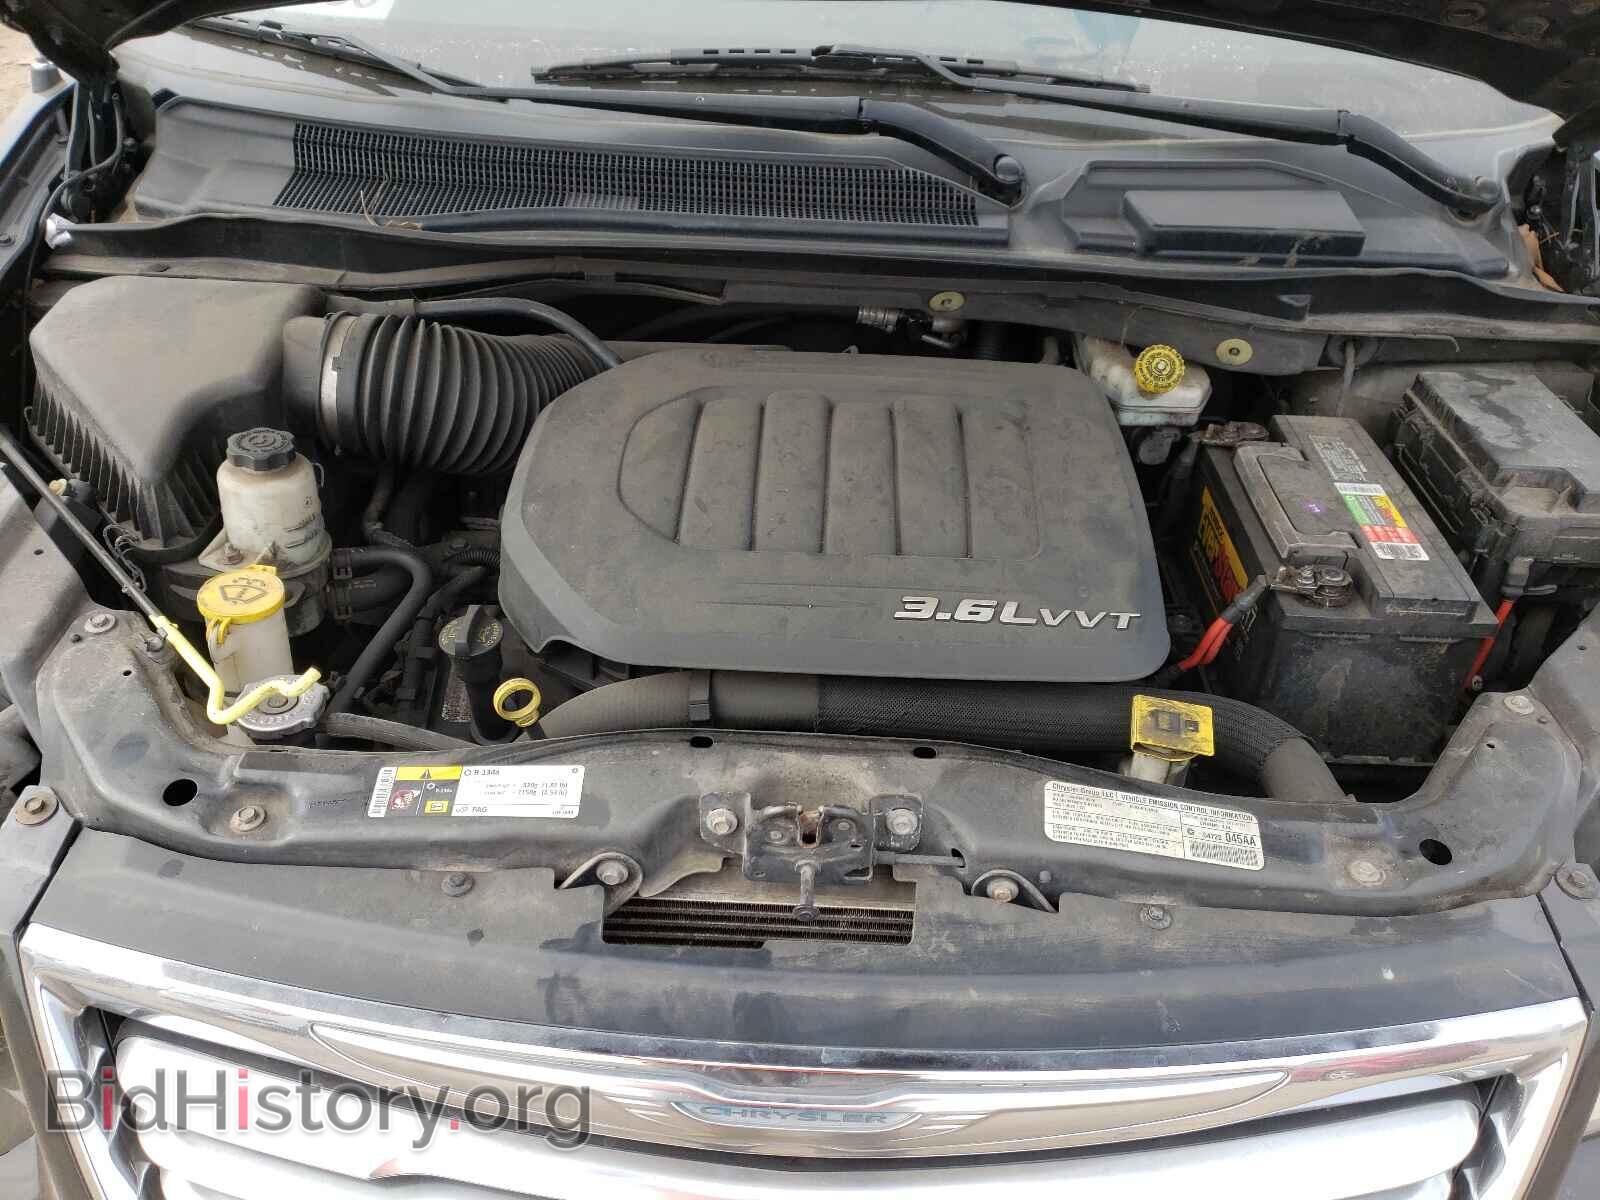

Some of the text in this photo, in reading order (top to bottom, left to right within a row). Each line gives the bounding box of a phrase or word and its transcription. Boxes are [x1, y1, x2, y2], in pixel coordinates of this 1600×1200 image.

[893, 595, 1142, 631] 3.6L VVT
[1052, 783, 1079, 793] Chrysler
[1080, 787, 1100, 797] Group
[1121, 795, 1148, 806] VEHICLE
[1148, 798, 1179, 809] EMISSION
[1180, 803, 1209, 814] CONTROL
[1210, 807, 1254, 822] INFORMATION
[699, 1106, 888, 1124] CHRYSLER
